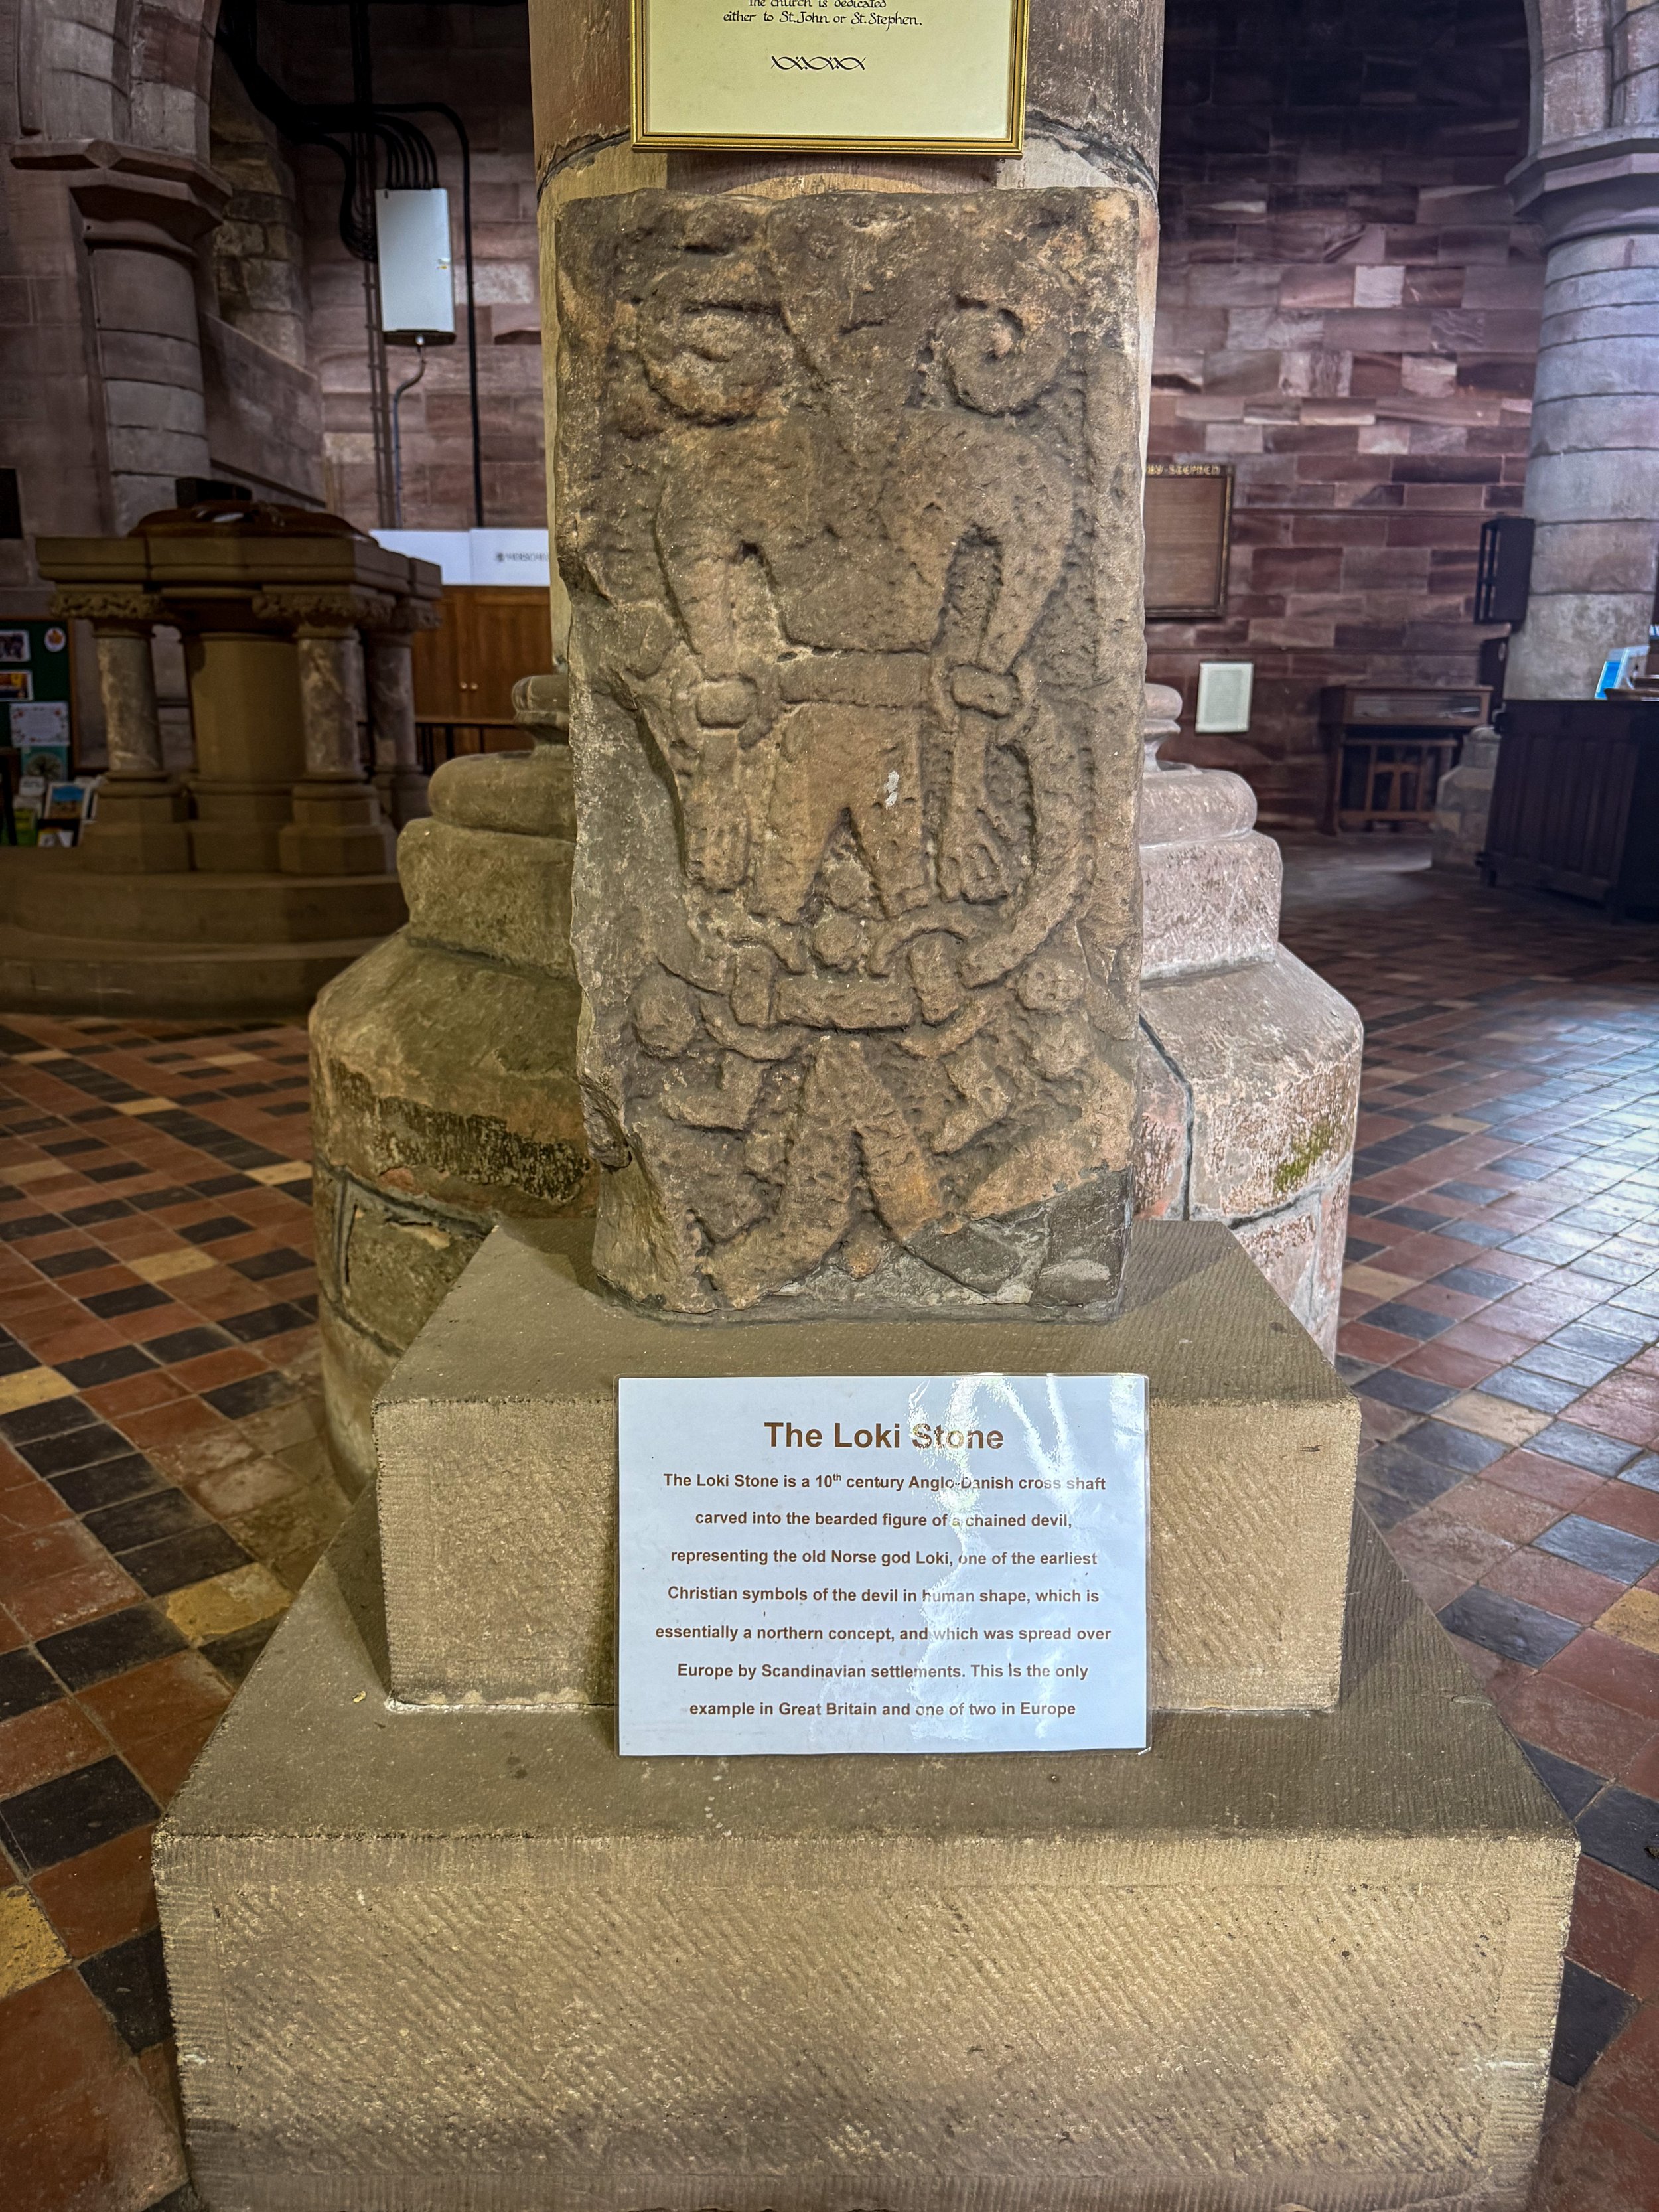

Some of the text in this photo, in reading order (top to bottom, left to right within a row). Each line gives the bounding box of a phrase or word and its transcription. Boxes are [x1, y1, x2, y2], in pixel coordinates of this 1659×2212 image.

[723, 10, 757, 22] either
[764, 11, 774, 21] to
[764, 1422, 1004, 1449] The Loki Stone
[663, 1473, 691, 1487] The
[697, 1474, 729, 1487] Loki
[734, 1474, 778, 1487] Stone
[784, 1475, 796, 1487] is
[802, 1478, 810, 1487] a
[846, 1476, 904, 1492] century
[1019, 1478, 1061, 1489] cross
[1066, 1477, 1106, 1491] shaft
[695, 1511, 1072, 1529] carved into the bearded figure of a chained devil,
[671, 1549, 1098, 1567] representing the old Norse god Loki, one of the earliest
[668, 1586, 1099, 1605] Christian symbols of the devil in human shape, which is
[656, 1625, 1112, 1643] essentially a northern concept, and which was spread over
[678, 1663, 1088, 1681] Europe by Scandinavian settlements. This is the only
[690, 1702, 1076, 1718] example in Great Britain and one of two in Europe
